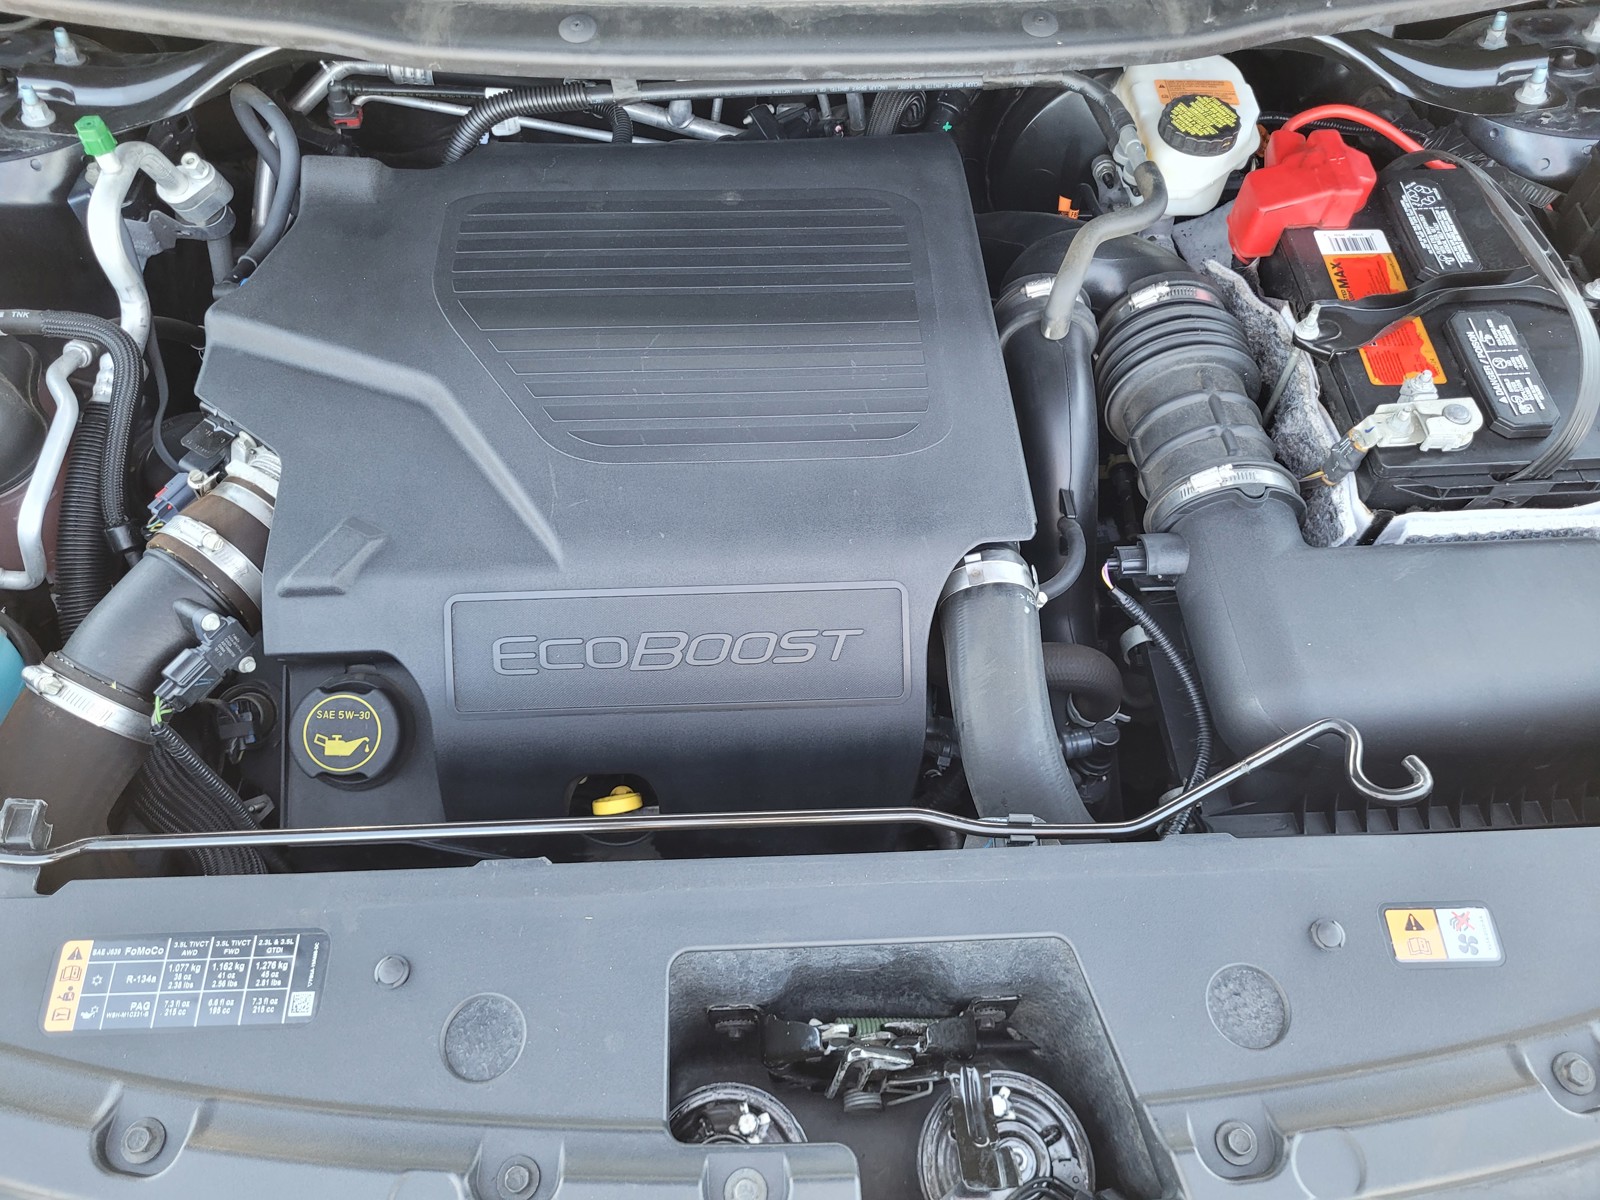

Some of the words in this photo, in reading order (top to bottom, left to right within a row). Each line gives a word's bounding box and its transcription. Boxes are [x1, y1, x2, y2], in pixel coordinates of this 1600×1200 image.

[1330, 262, 1350, 289] MAX
[1466, 331, 1486, 358] POISON
[1483, 364, 1505, 396] DANGER
[316, 710, 336, 719] SAE
[338, 710, 371, 720] 5W-30
[125, 946, 164, 956] FoMoCo
[169, 963, 190, 972] 1.077
[191, 963, 201, 974] kg
[234, 962, 245, 972] kg
[278, 961, 289, 971] kg
[126, 974, 157, 984] R-134a
[130, 1001, 151, 1011] PAG
